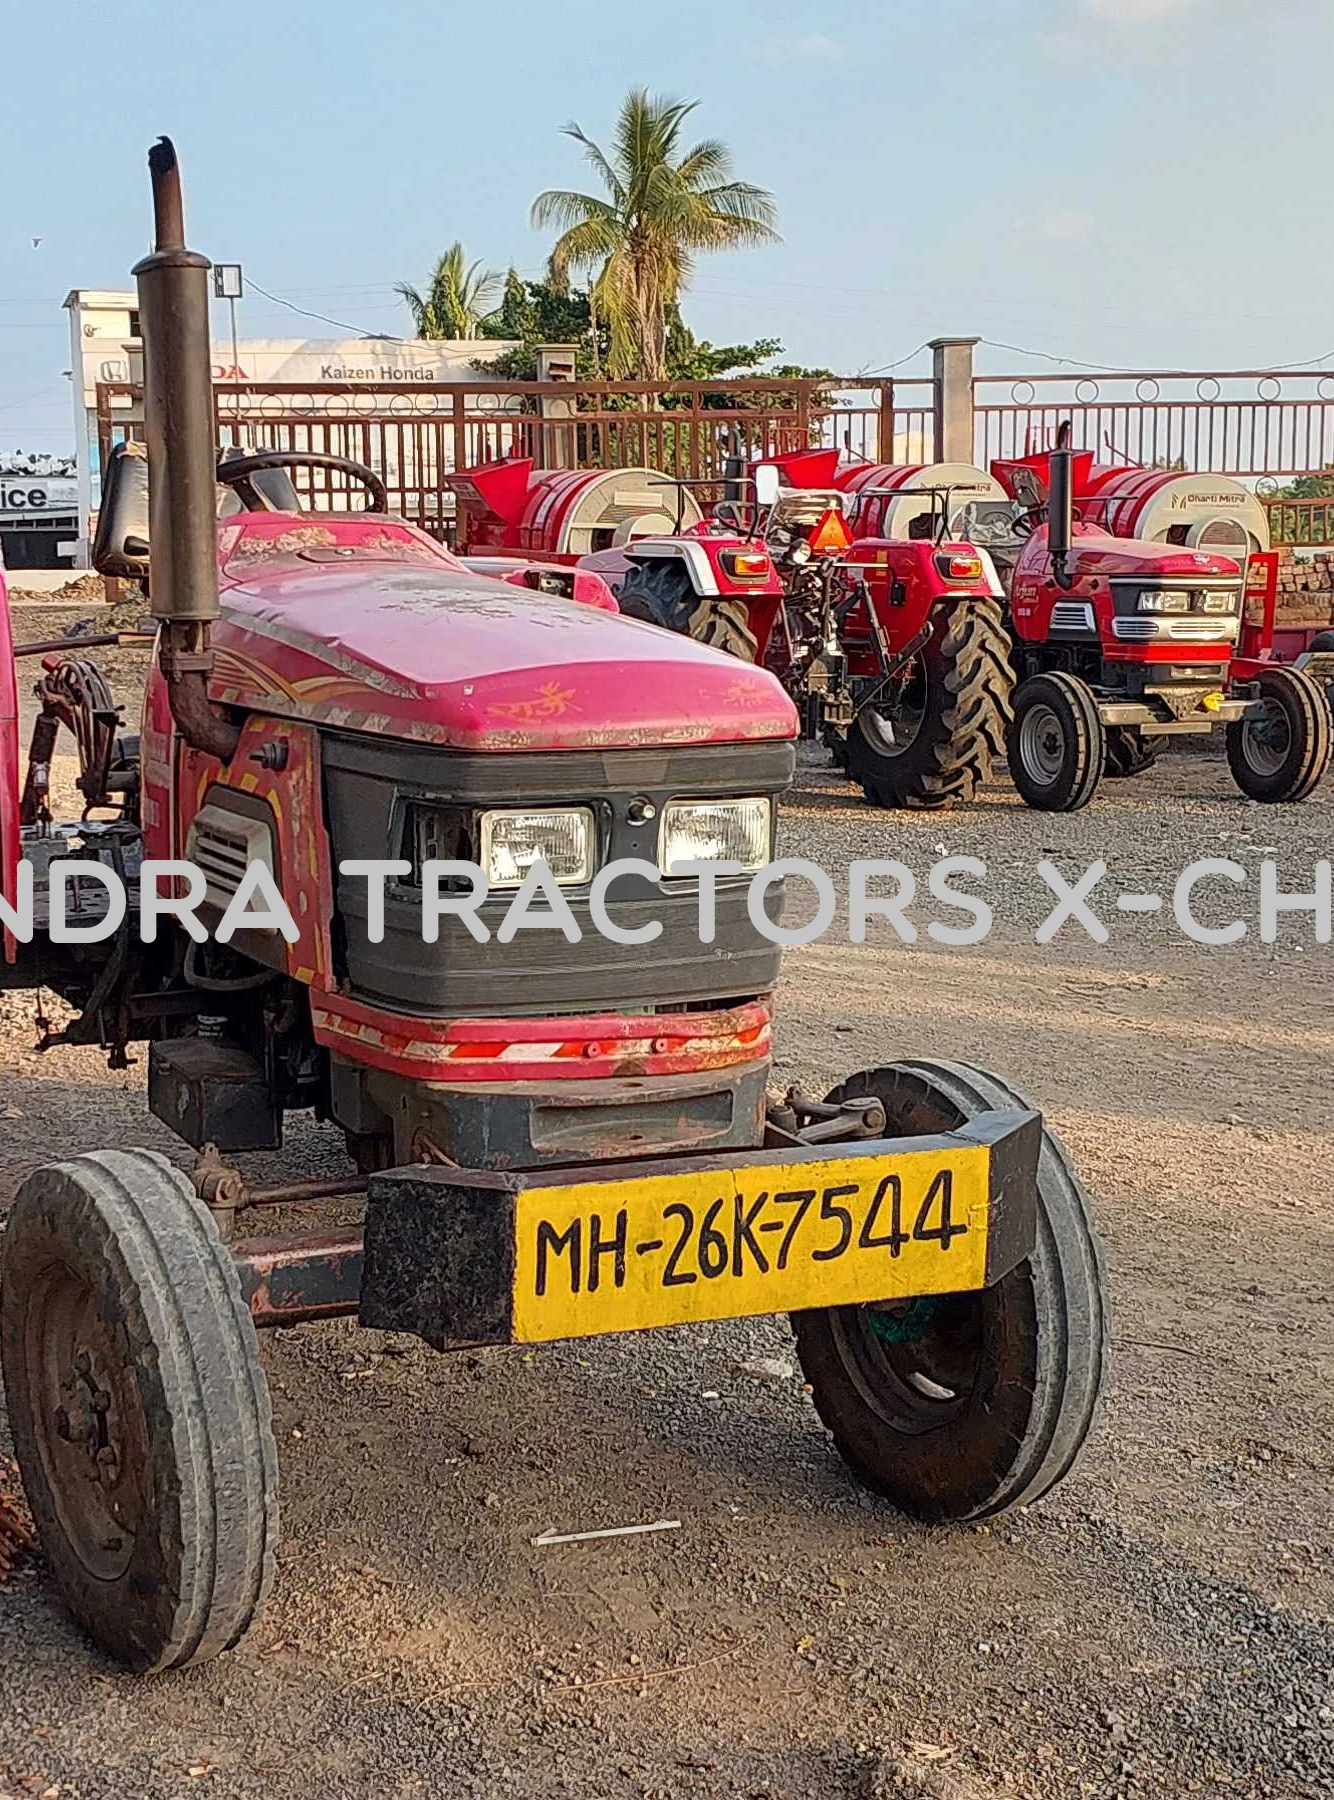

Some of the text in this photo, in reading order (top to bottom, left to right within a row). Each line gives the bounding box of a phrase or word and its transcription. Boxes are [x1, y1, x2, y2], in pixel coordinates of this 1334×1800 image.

[321, 365, 434, 380] Kaizen Honda
[1219, 494, 1245, 503] Mitra
[534, 1170, 967, 1296] MH-26K-7544
